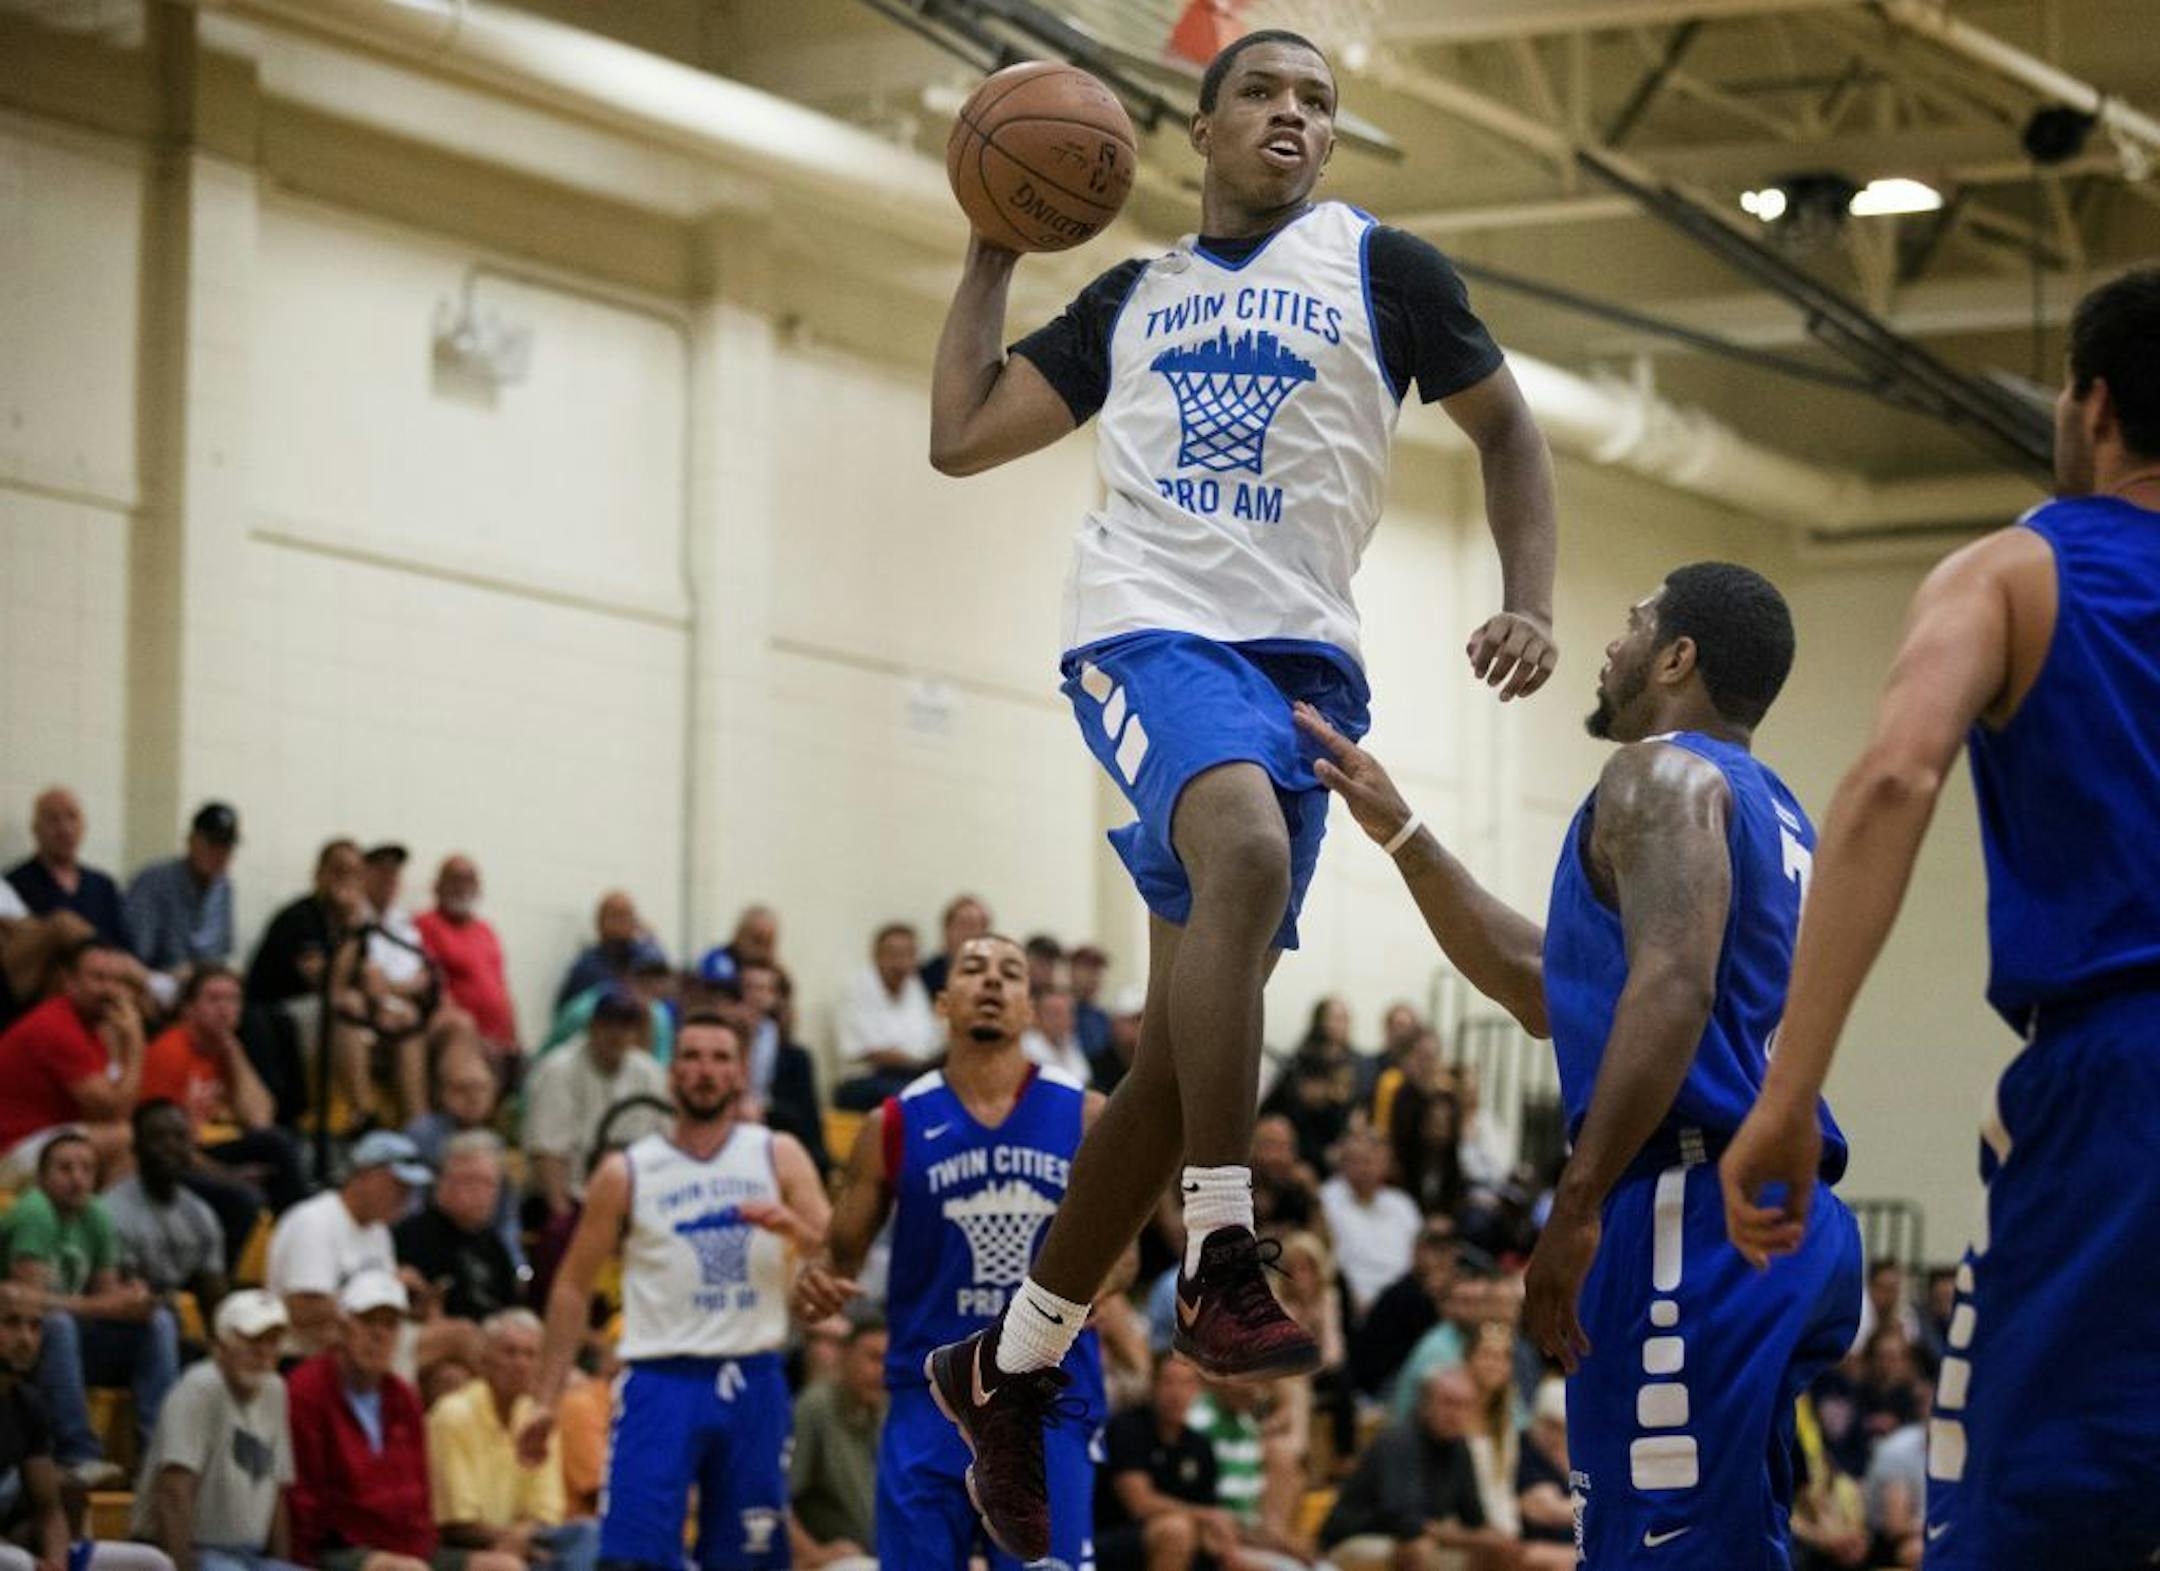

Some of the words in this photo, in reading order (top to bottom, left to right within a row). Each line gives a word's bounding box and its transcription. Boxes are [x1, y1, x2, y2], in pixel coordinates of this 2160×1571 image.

[1146, 292, 1226, 339] TWIN
[1236, 288, 1342, 345] CITIES
[1155, 478, 1220, 514] PRO
[1233, 482, 1283, 523] AM
[927, 1147, 988, 1194] TWIN
